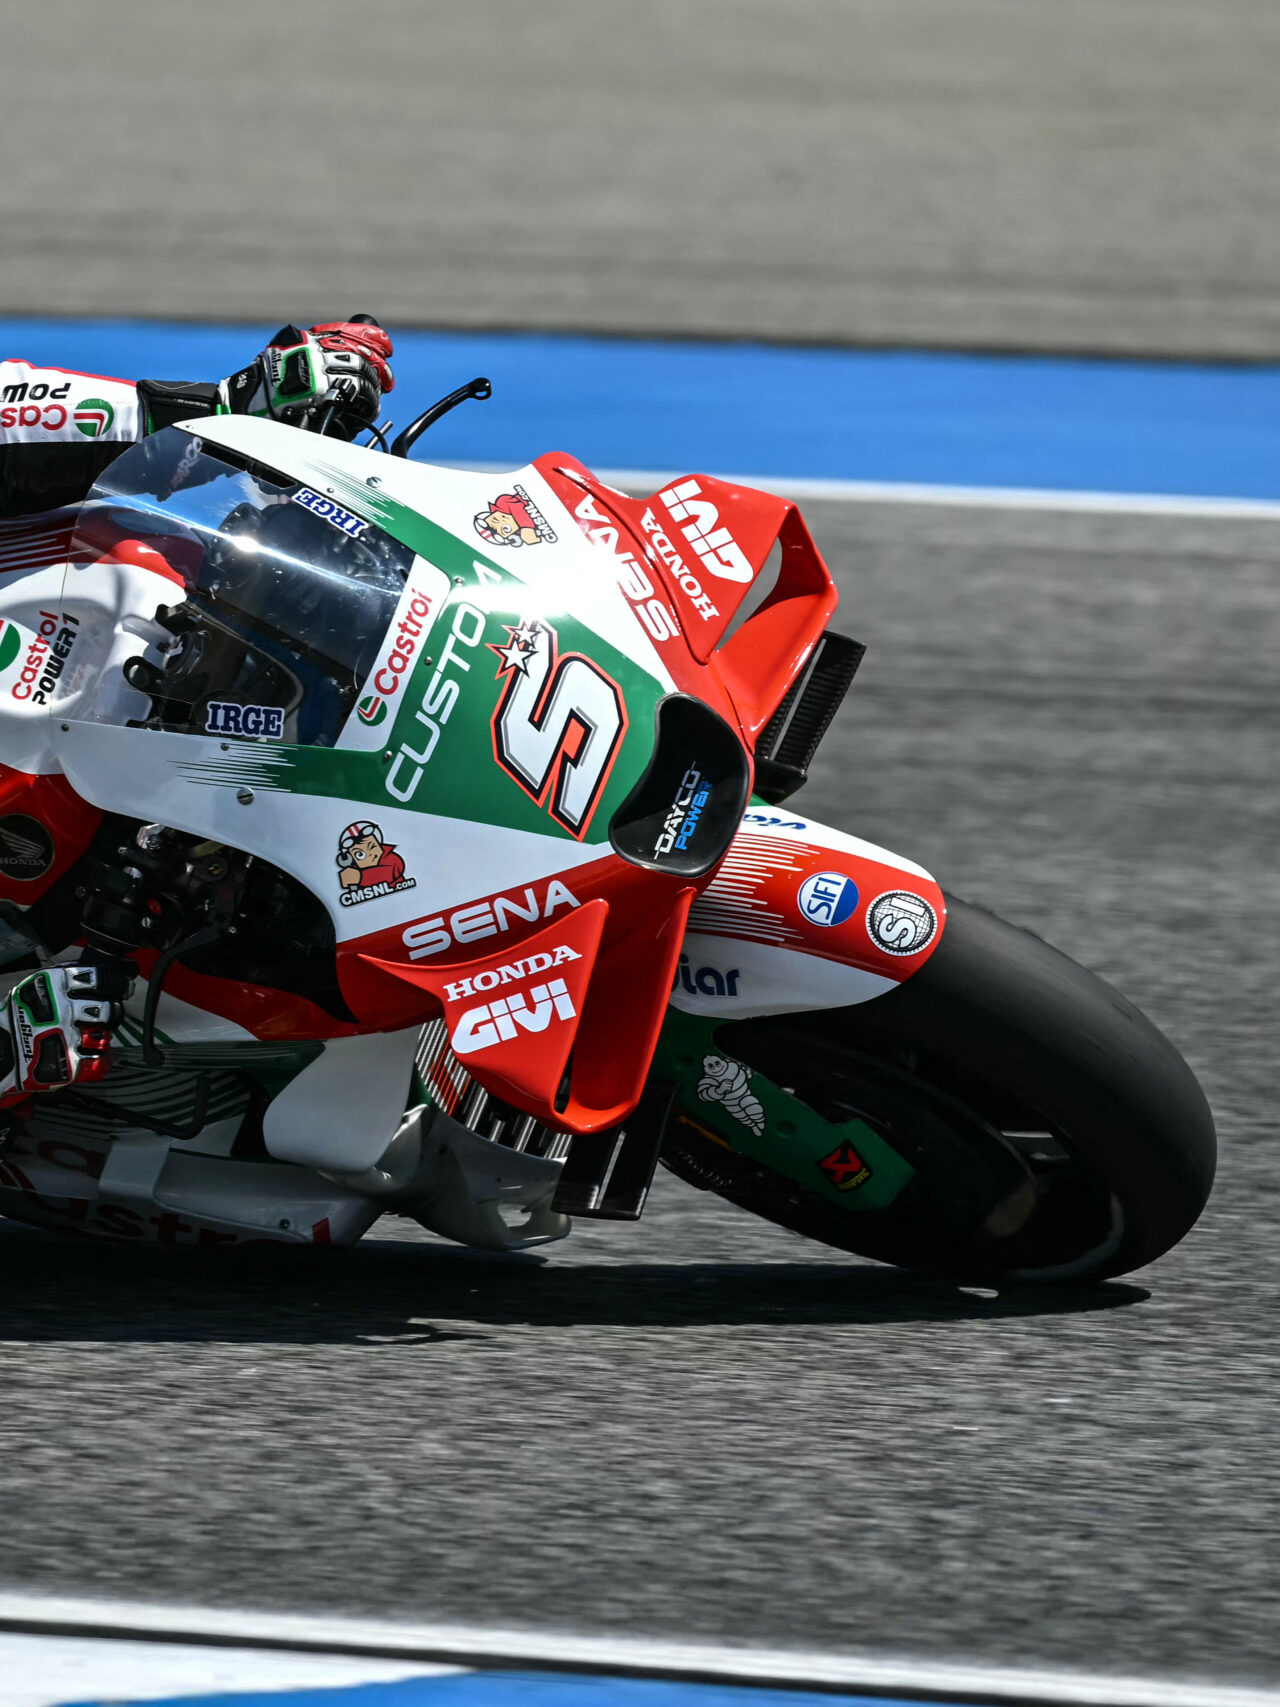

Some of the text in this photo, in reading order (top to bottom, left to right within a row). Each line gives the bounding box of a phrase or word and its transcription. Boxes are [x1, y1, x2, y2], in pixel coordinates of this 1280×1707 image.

[293, 488, 368, 537] IRGE
[659, 479, 754, 583] GIVI
[641, 507, 719, 621] HONDA
[11, 611, 58, 700] Castrol
[32, 613, 80, 706] POWER1
[374, 588, 432, 696] Castrol
[206, 703, 283, 738] IRGE
[491, 617, 629, 840] 5
[653, 762, 702, 859] DAYCO
[674, 780, 712, 850] POWER
[341, 878, 416, 907] CMSNL.COM
[402, 880, 581, 961] SENA
[808, 877, 841, 921] SIFI
[443, 944, 582, 1002] HONDA
[672, 954, 740, 997] iar
[451, 978, 576, 1054] GIVI
